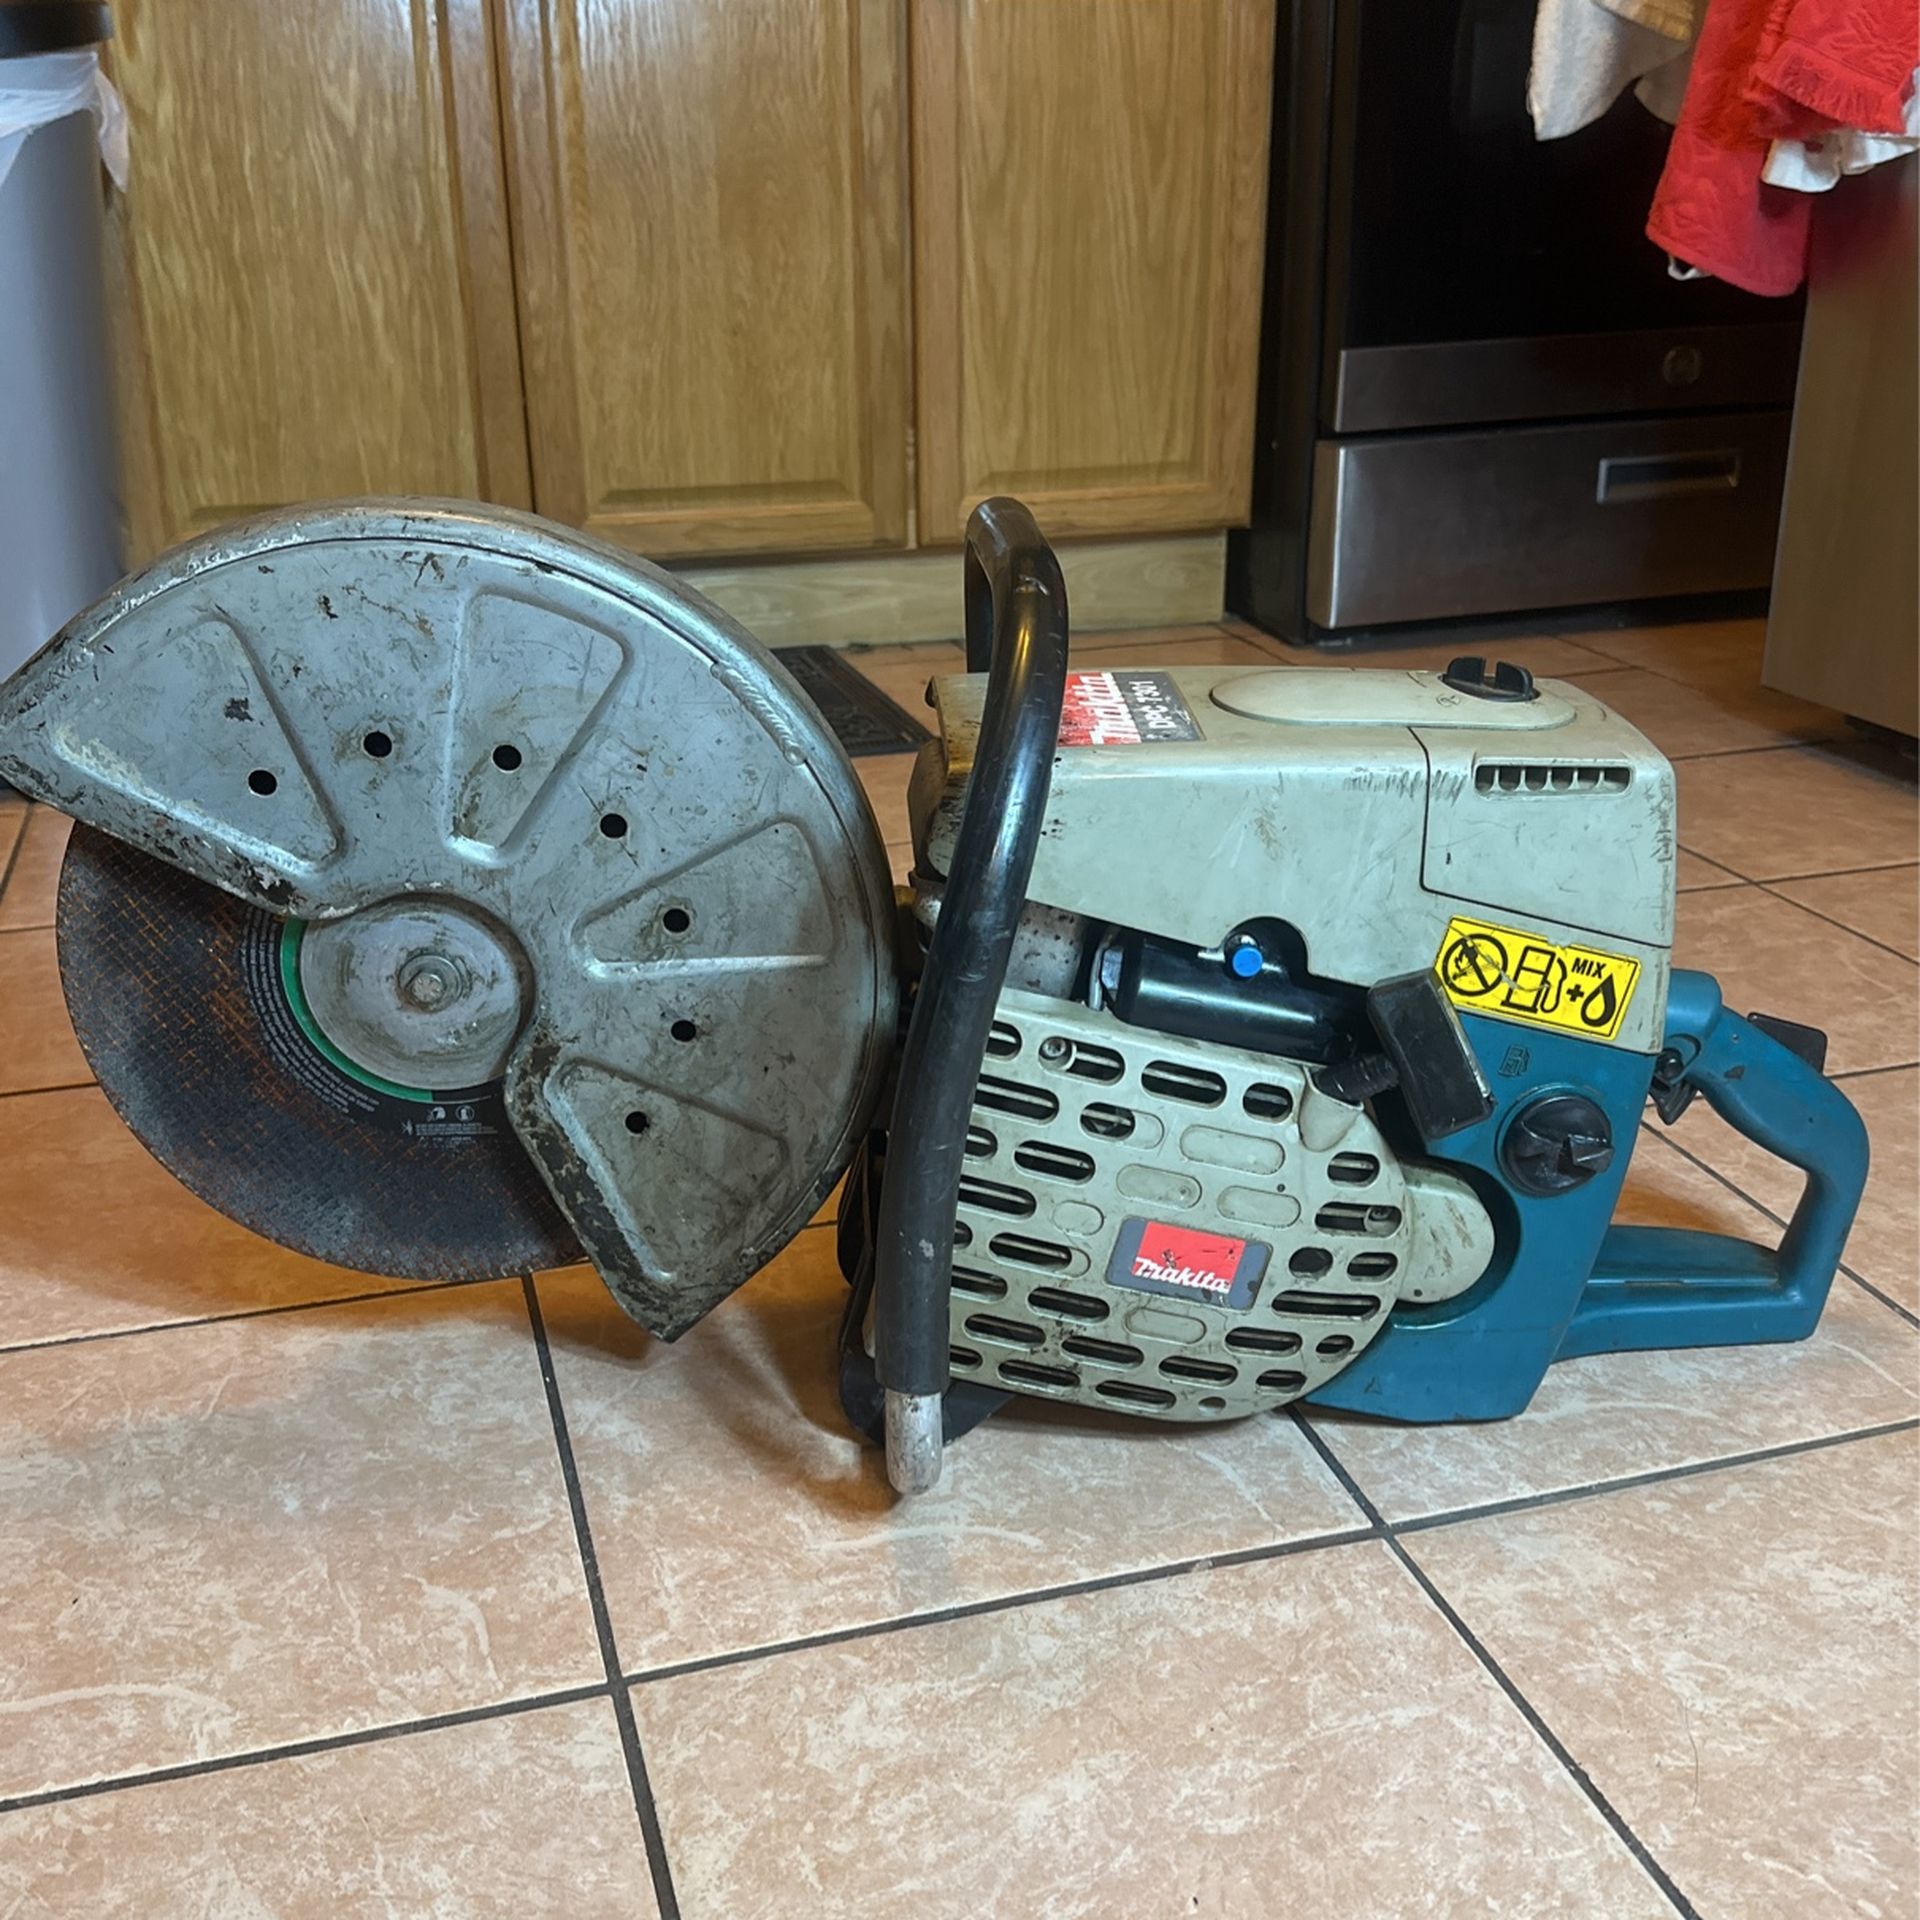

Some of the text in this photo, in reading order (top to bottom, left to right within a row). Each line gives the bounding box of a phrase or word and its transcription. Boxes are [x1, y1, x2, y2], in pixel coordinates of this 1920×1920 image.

[1129, 680, 1177, 729] DPC 7301
[1571, 957, 1607, 979] MIX
